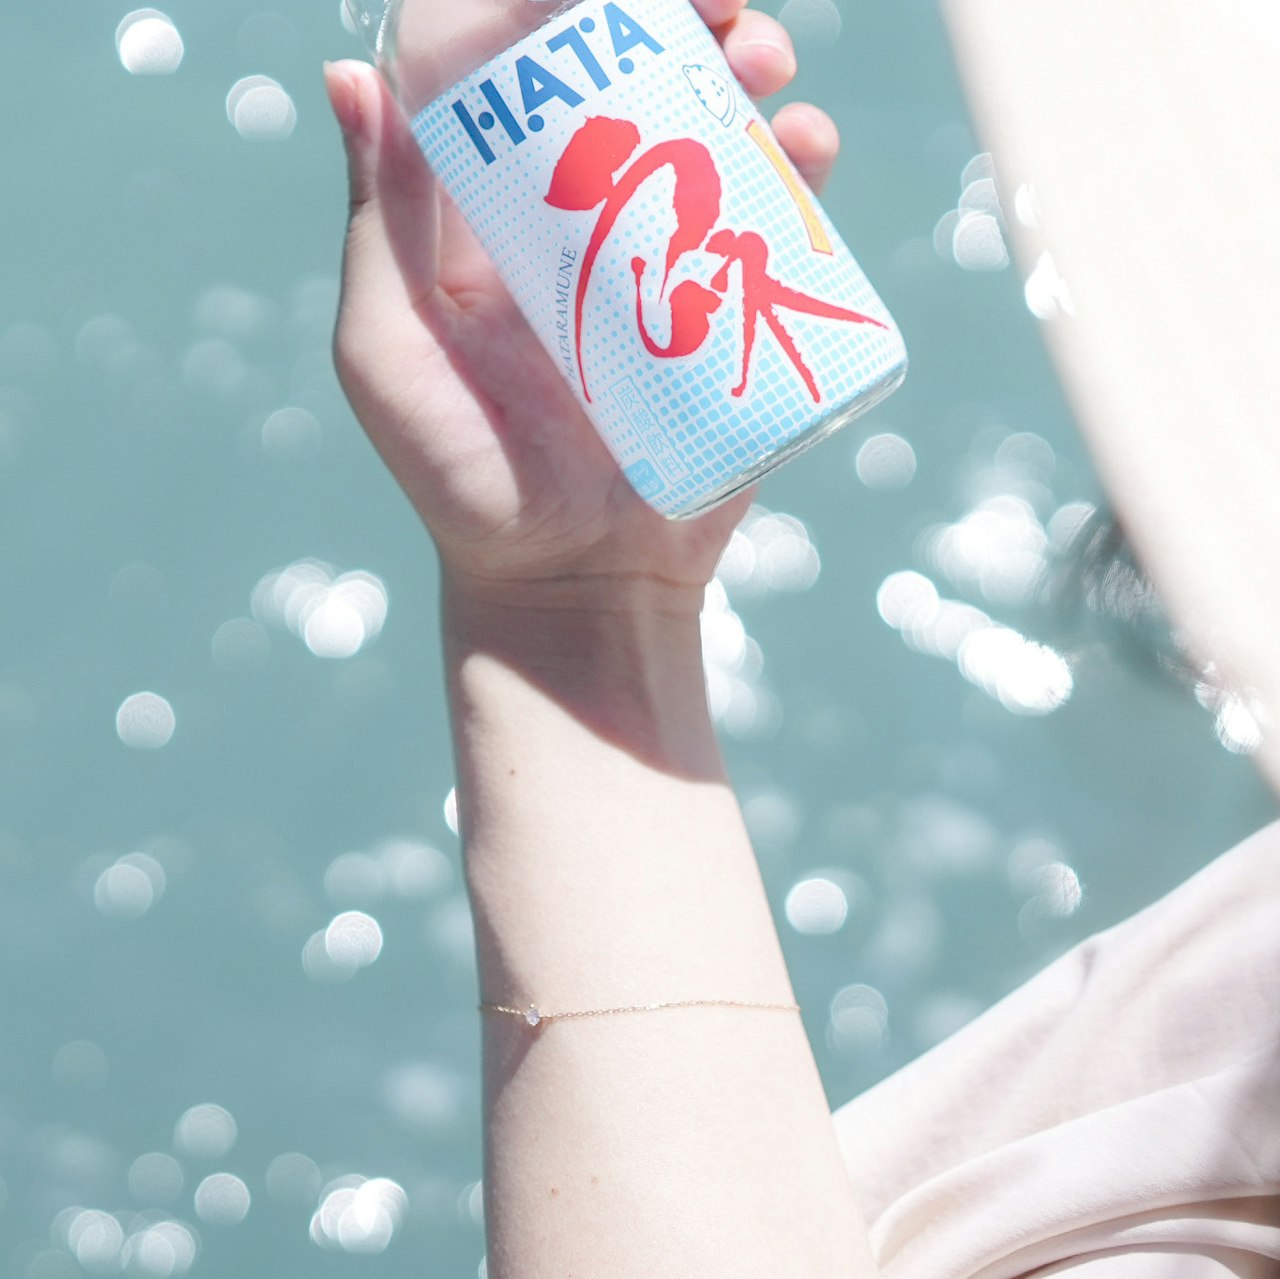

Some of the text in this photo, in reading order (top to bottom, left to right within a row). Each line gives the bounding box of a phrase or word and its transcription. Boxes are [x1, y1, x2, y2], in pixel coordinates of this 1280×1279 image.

[452, 1, 665, 166] HATA
[614, 383, 685, 479] 炭酸飲料
